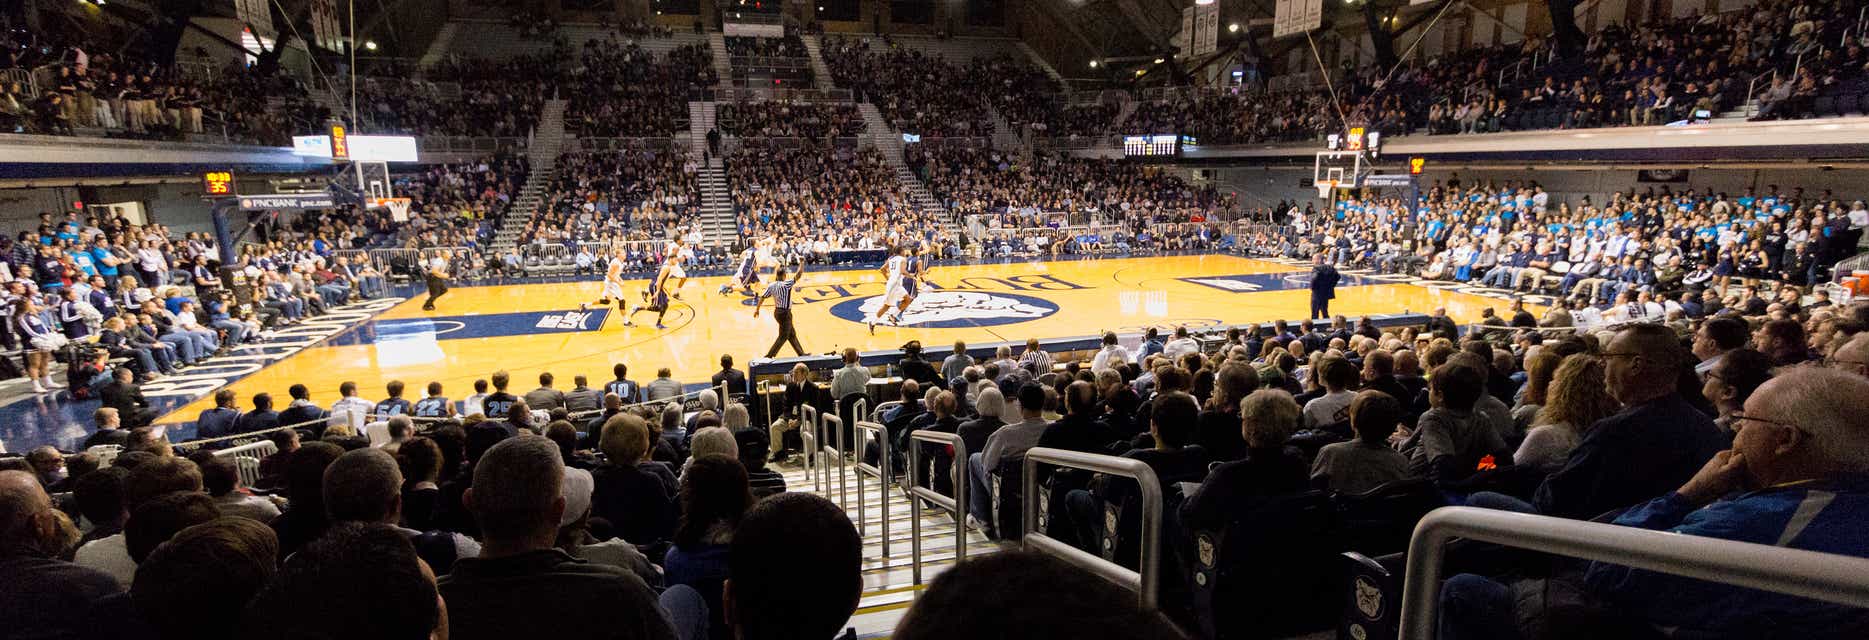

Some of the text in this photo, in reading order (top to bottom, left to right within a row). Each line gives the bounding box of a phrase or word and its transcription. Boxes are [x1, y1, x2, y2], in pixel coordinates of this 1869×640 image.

[741, 274, 1098, 307] BUTER
[610, 382, 629, 398] 10
[417, 400, 441, 417] 22
